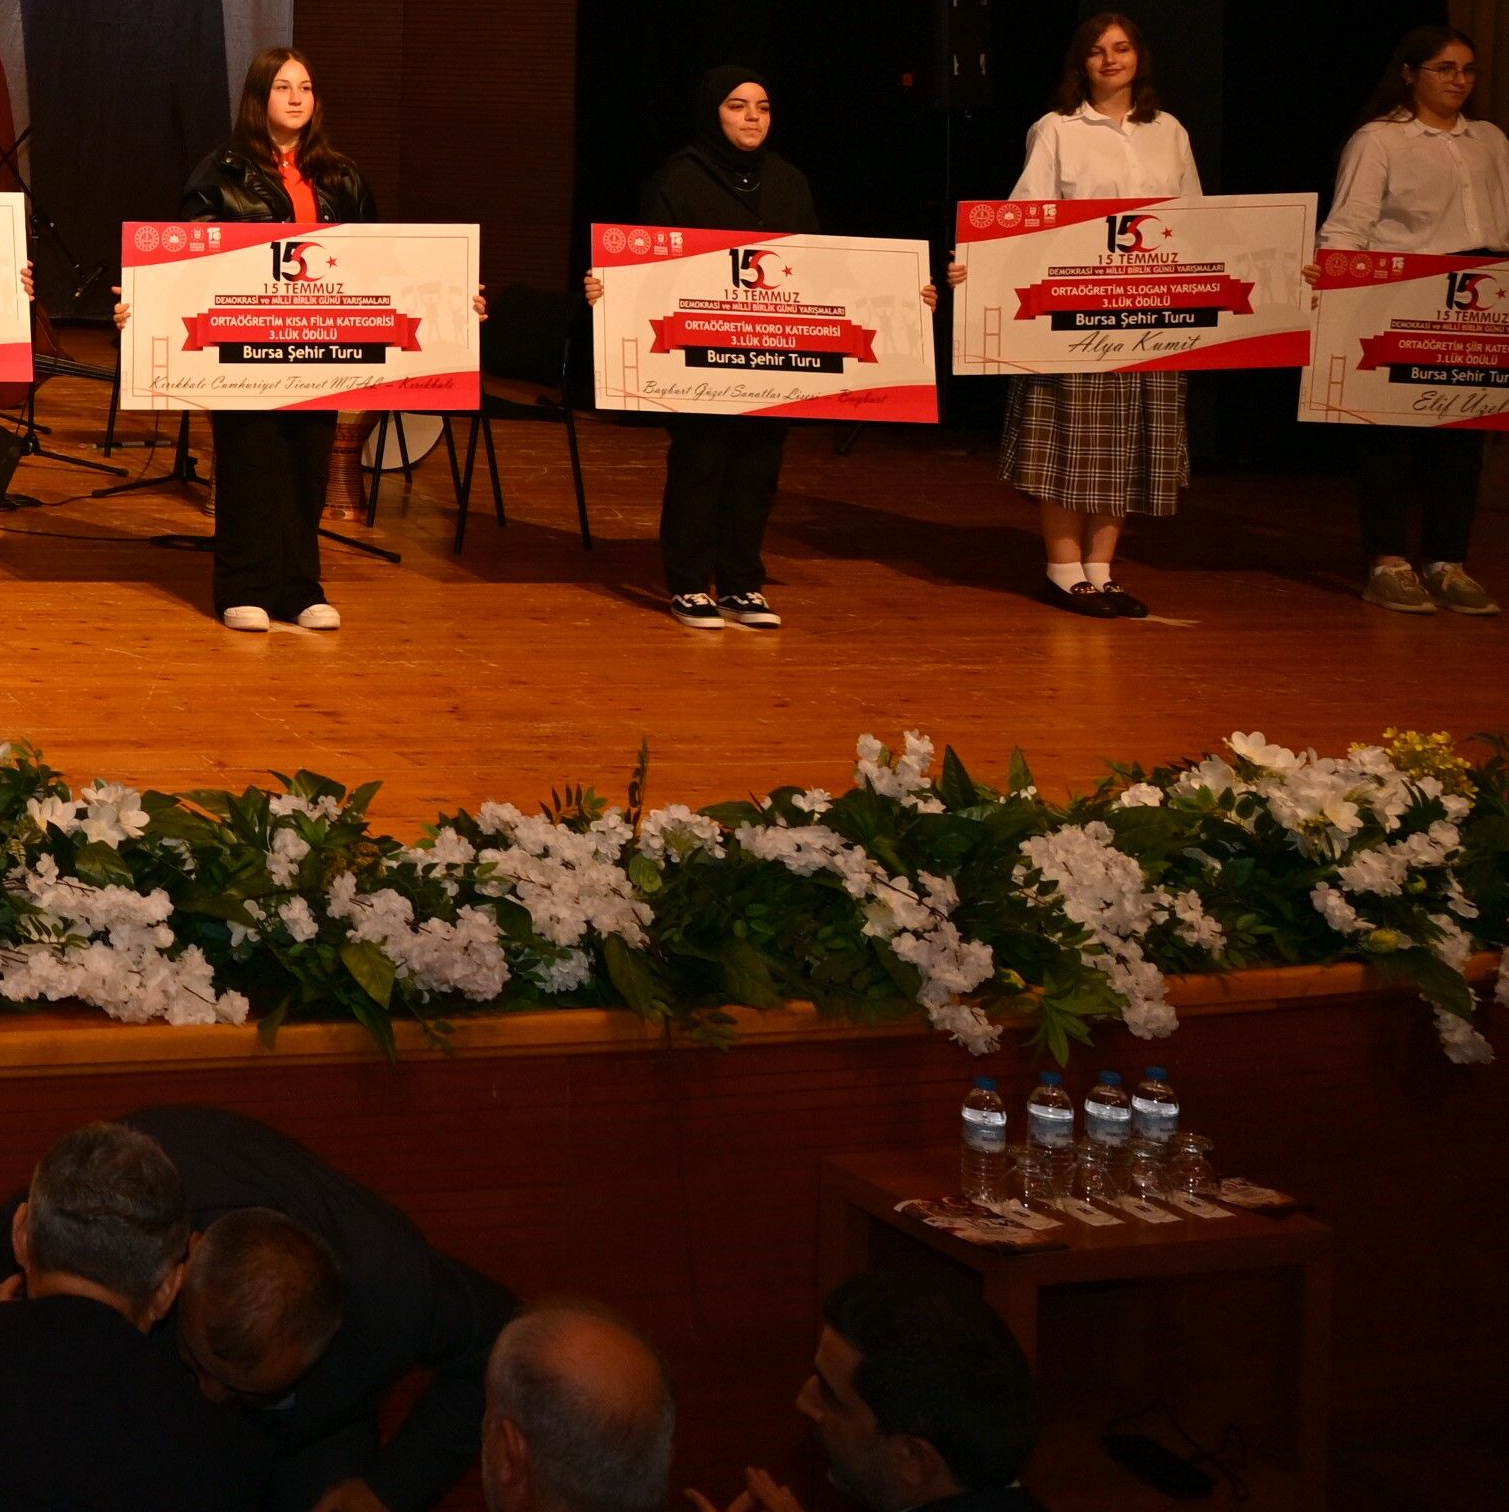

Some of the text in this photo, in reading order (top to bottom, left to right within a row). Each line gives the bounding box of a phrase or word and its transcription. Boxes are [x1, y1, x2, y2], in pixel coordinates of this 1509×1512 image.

[1098, 253, 1178, 265] 15 TEMMUZ
[263, 283, 344, 294] 15 TEMMUZ
[1051, 283, 1220, 296] ORTAÖĞRETİM SLOGAN YARIŞMASI
[724, 289, 800, 303] 15 TEMMUZ
[1102, 296, 1170, 308] 3.LÜK ÖDÜLÜ
[210, 315, 394, 326] ORTAÖĞRETİM KISA FİLM KATEGORİSİ
[1076, 312, 1194, 327] Bursa Şehir Turu
[1436, 311, 1509, 323] 15 TEMMUZ
[269, 328, 337, 340] 3.LÜK ÖDÜLÜ
[685, 319, 841, 337] ORTAÖĞRETİM KORO KATEGORİSİ
[732, 337, 796, 348] 3.LÜK ÖDÜLÜ
[243, 346, 362, 362] Bursa Şehir Turu
[707, 350, 820, 368] Bursa Şehir Turu
[1411, 368, 1509, 383] Bursa Şehir Tur
